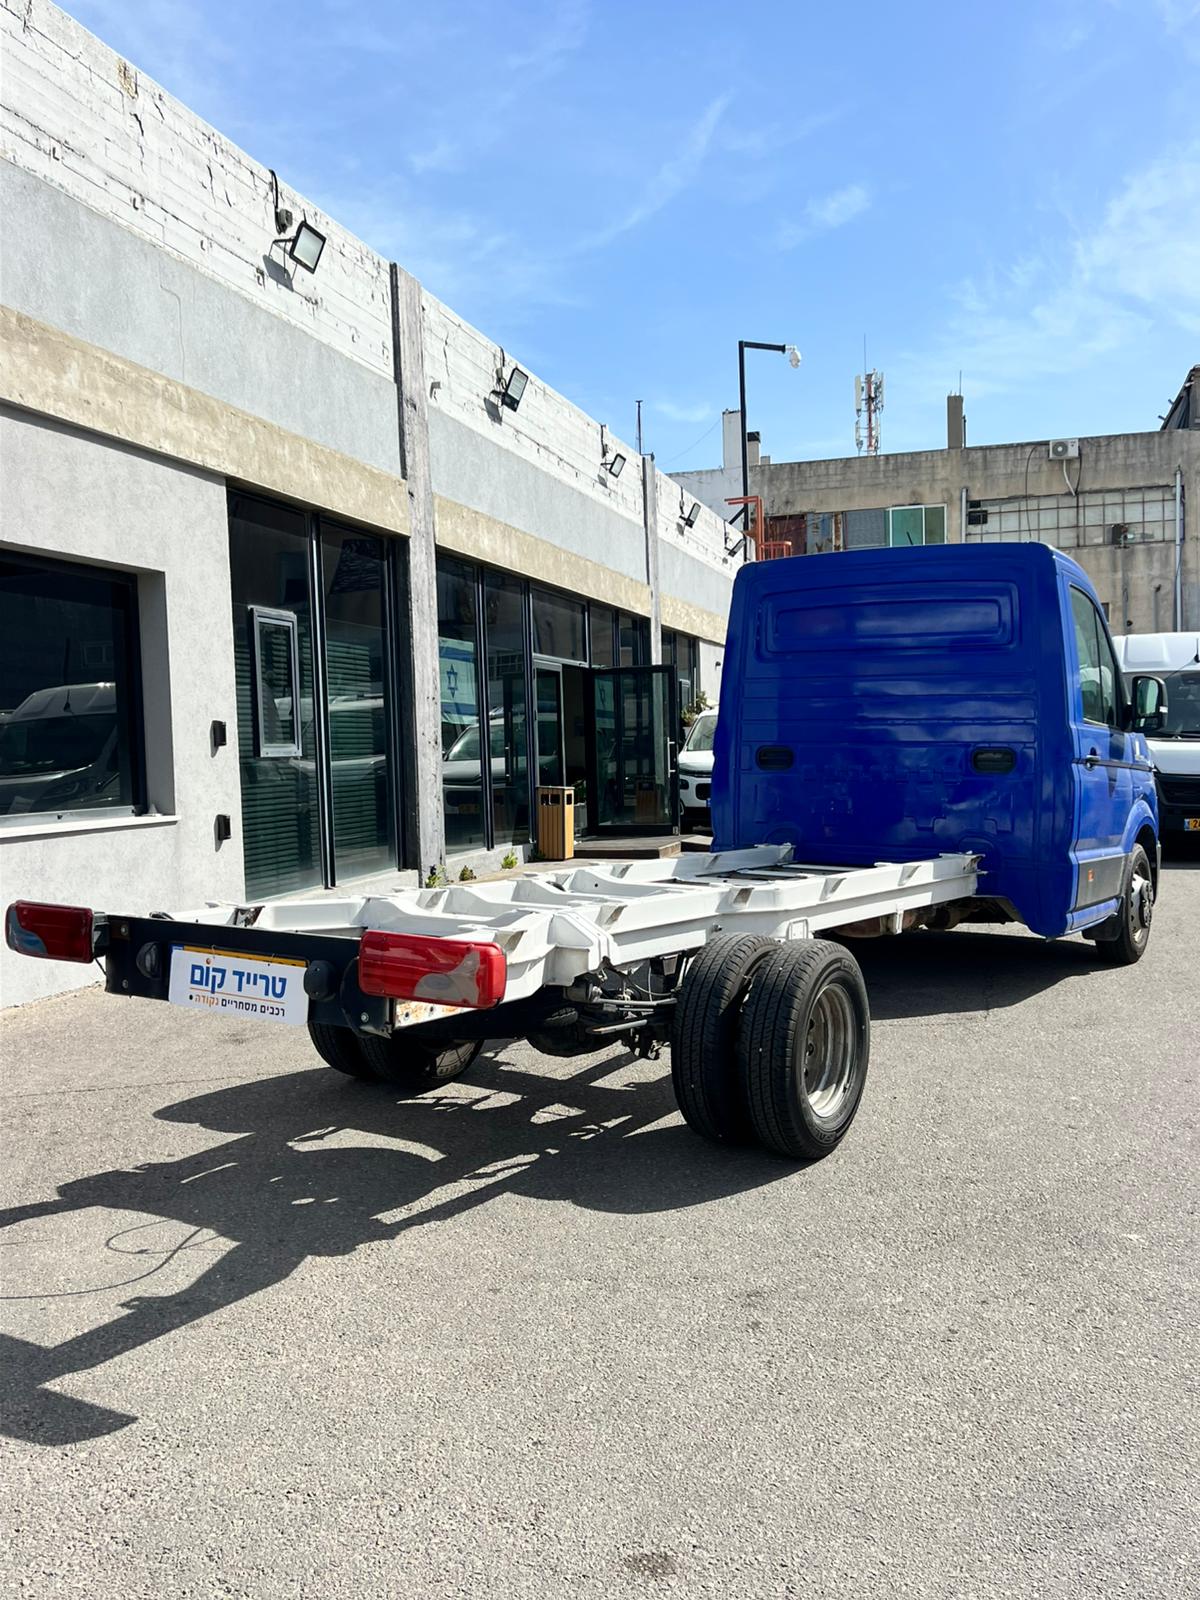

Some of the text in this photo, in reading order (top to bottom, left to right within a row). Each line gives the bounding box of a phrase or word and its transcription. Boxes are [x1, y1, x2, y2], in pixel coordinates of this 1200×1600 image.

[190, 964, 287, 998] טרייד קום
[194, 994, 285, 1016] רכבים מסחריים נקודה
